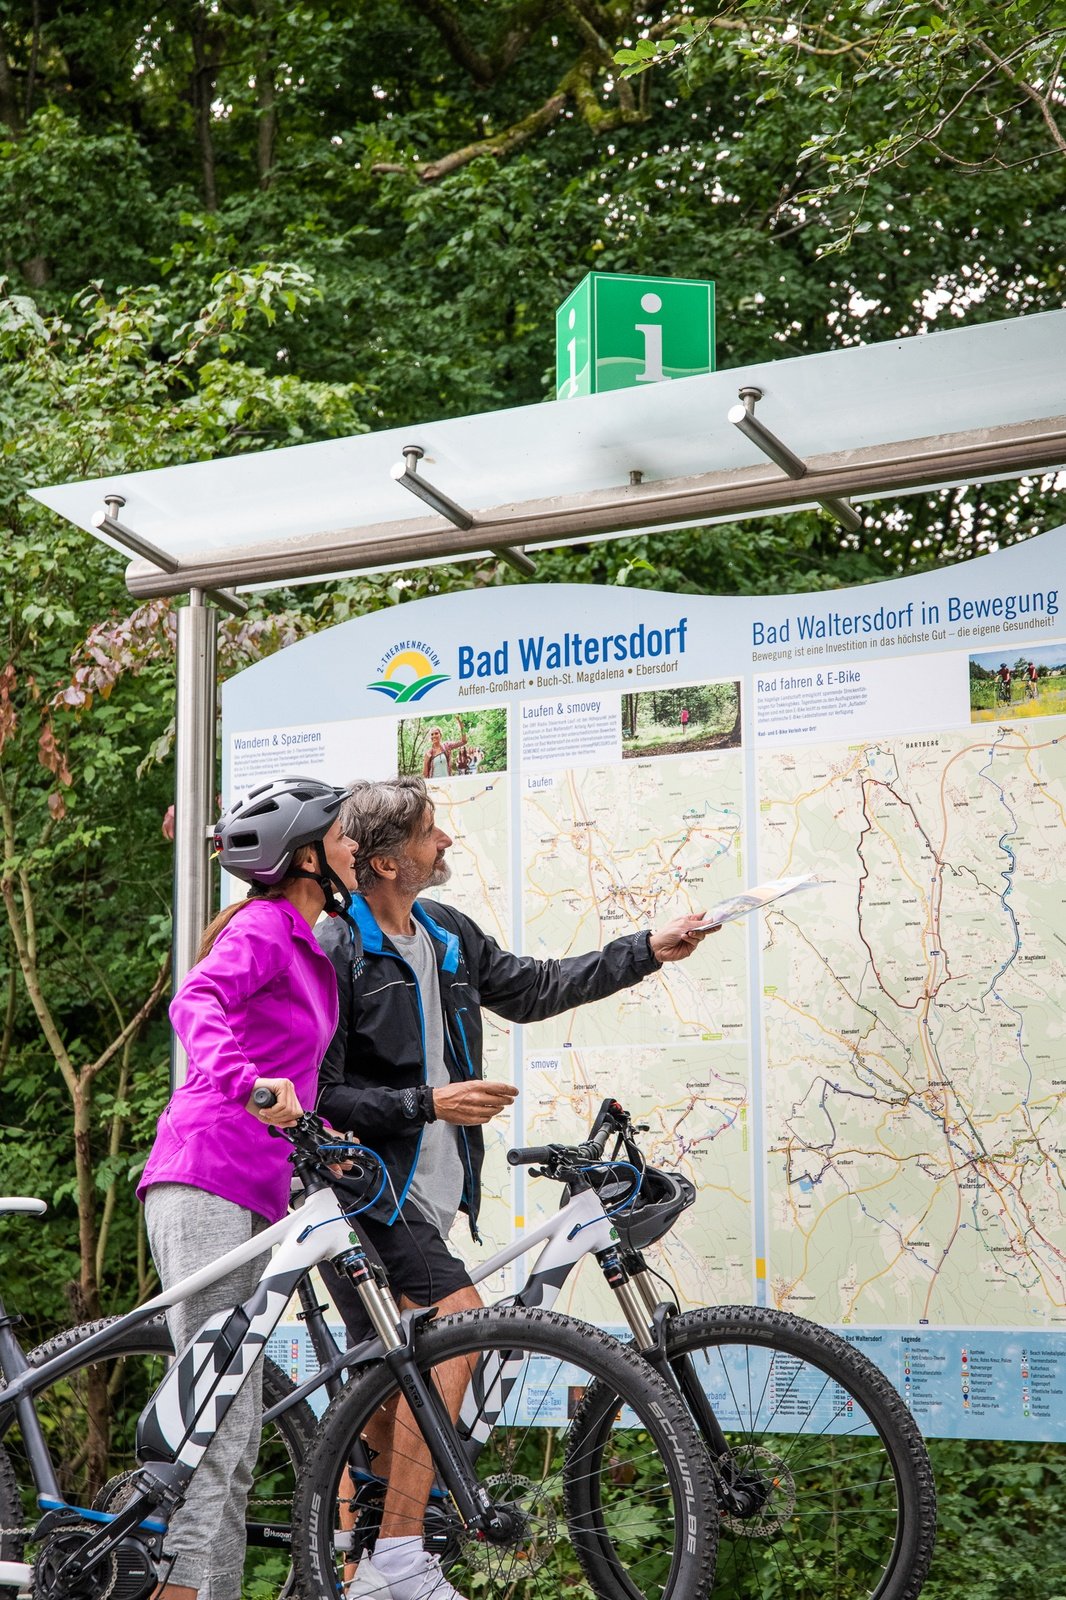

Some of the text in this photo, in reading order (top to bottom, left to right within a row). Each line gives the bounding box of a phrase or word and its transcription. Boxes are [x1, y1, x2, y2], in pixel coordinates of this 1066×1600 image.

[752, 590, 1059, 646] Bad Waltersdorf in Bewegung
[458, 617, 688, 680] Bad Waltersdorf
[752, 650, 792, 662] Bewegung
[794, 646, 805, 657] ist
[806, 644, 824, 656] eine
[826, 640, 868, 654] Investition
[870, 638, 878, 648] in
[879, 635, 895, 647] das
[897, 630, 930, 646] höchste
[932, 629, 947, 641] Gut
[957, 625, 971, 638] die
[972, 624, 1001, 637] eigene
[1002, 616, 1055, 632] Gesundheit!
[458, 660, 678, 697] Auffen-Großhart Buch-St. Magdalena Ebersdorf
[757, 670, 861, 693] Rad fahren & E-Bike
[523, 700, 601, 719] Laufen & smovey
[234, 731, 321, 750] Wandern & Spazieren
[906, 739, 939, 748] HARTBERG
[527, 776, 553, 788] Laufen
[530, 1060, 559, 1070] smovey
[648, 1401, 697, 1555] SCHWALBE
[308, 1492, 324, 1585] SMART
